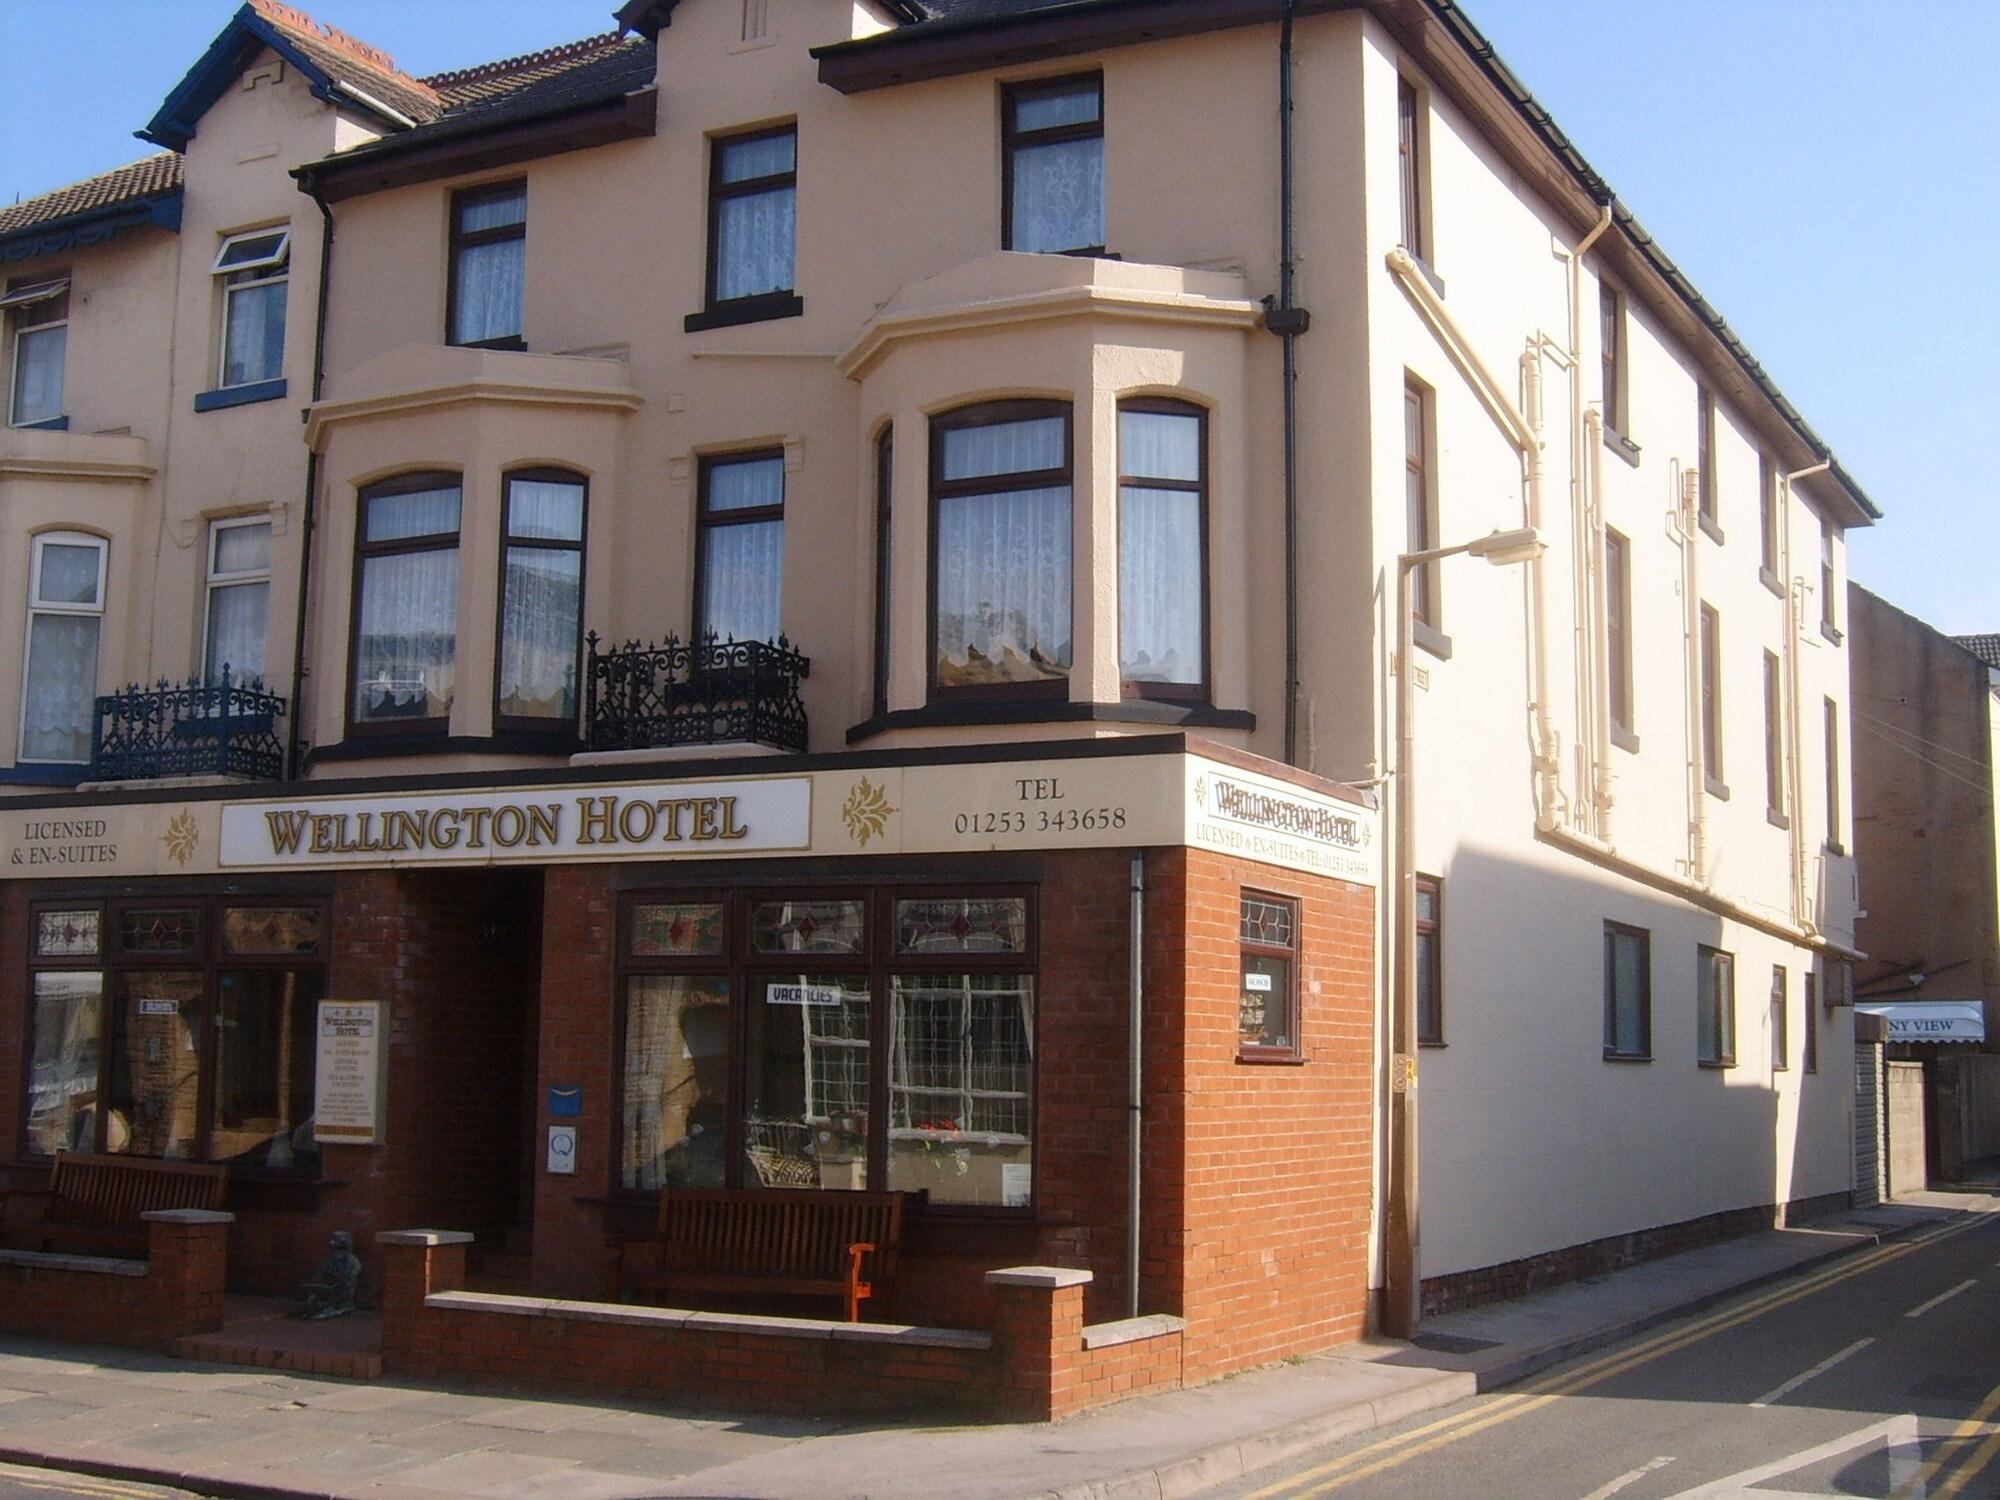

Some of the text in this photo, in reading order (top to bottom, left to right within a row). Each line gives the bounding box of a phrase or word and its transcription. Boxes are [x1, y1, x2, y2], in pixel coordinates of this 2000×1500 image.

[1015, 777, 1065, 801] TEL
[264, 796, 748, 855] WELLINGTON HOTEL
[954, 807, 1127, 834] 01253 343658
[1213, 779, 1361, 847] WELLINGTON HOTEL
[24, 819, 106, 841] LICENSED
[1196, 821, 1243, 850] LICENSED
[1253, 836, 1299, 862] EN-SUITES
[11, 844, 118, 865] & EN-SUITES
[1913, 1019, 1954, 1032] VIEW
